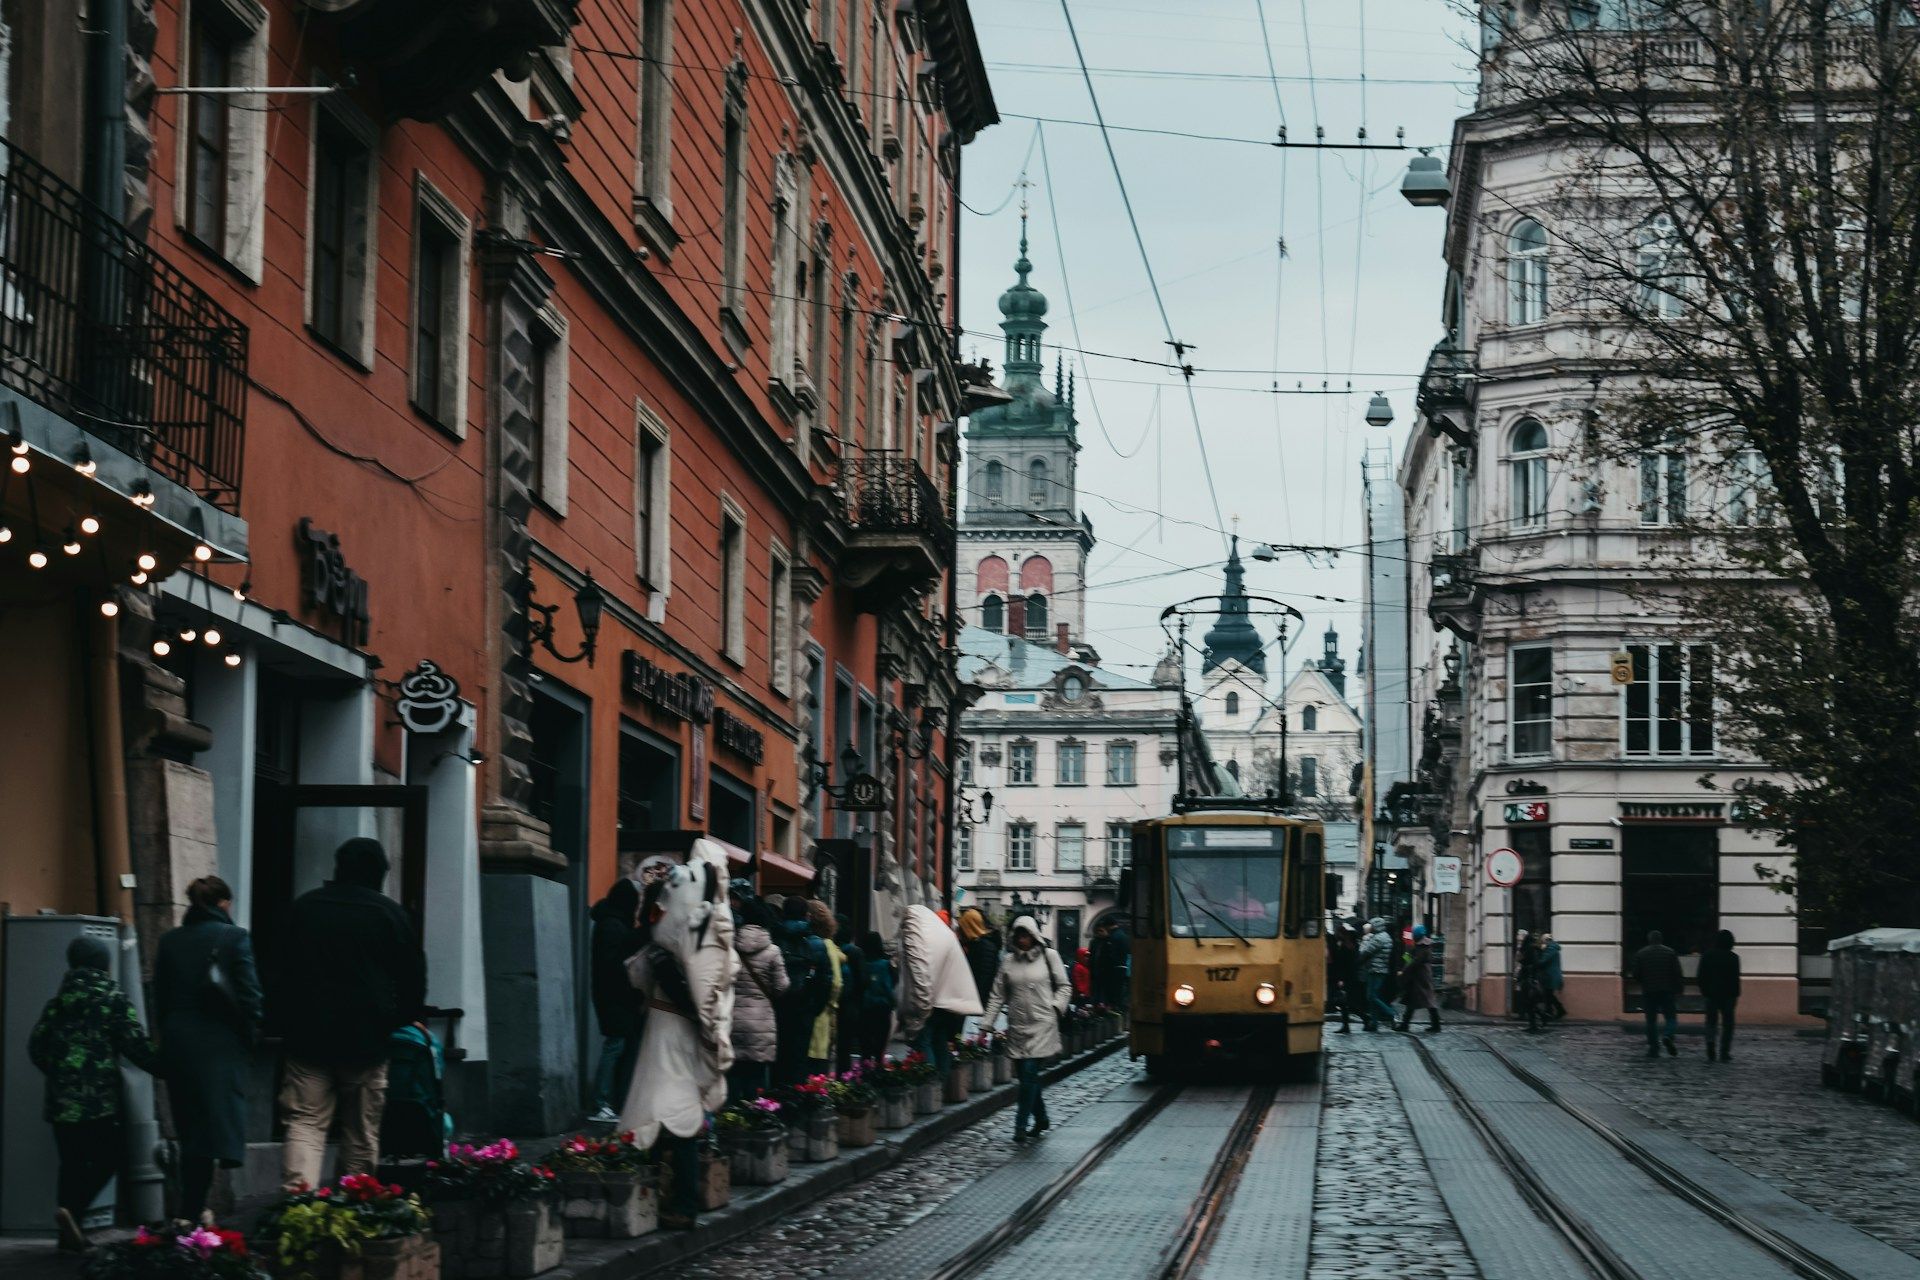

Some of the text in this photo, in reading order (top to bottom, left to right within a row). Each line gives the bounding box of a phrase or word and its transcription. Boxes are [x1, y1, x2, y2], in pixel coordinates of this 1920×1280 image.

[1620, 803, 1723, 817] RISTORANTE
[1180, 829, 1196, 847] 1
[1206, 965, 1239, 981] 1127
